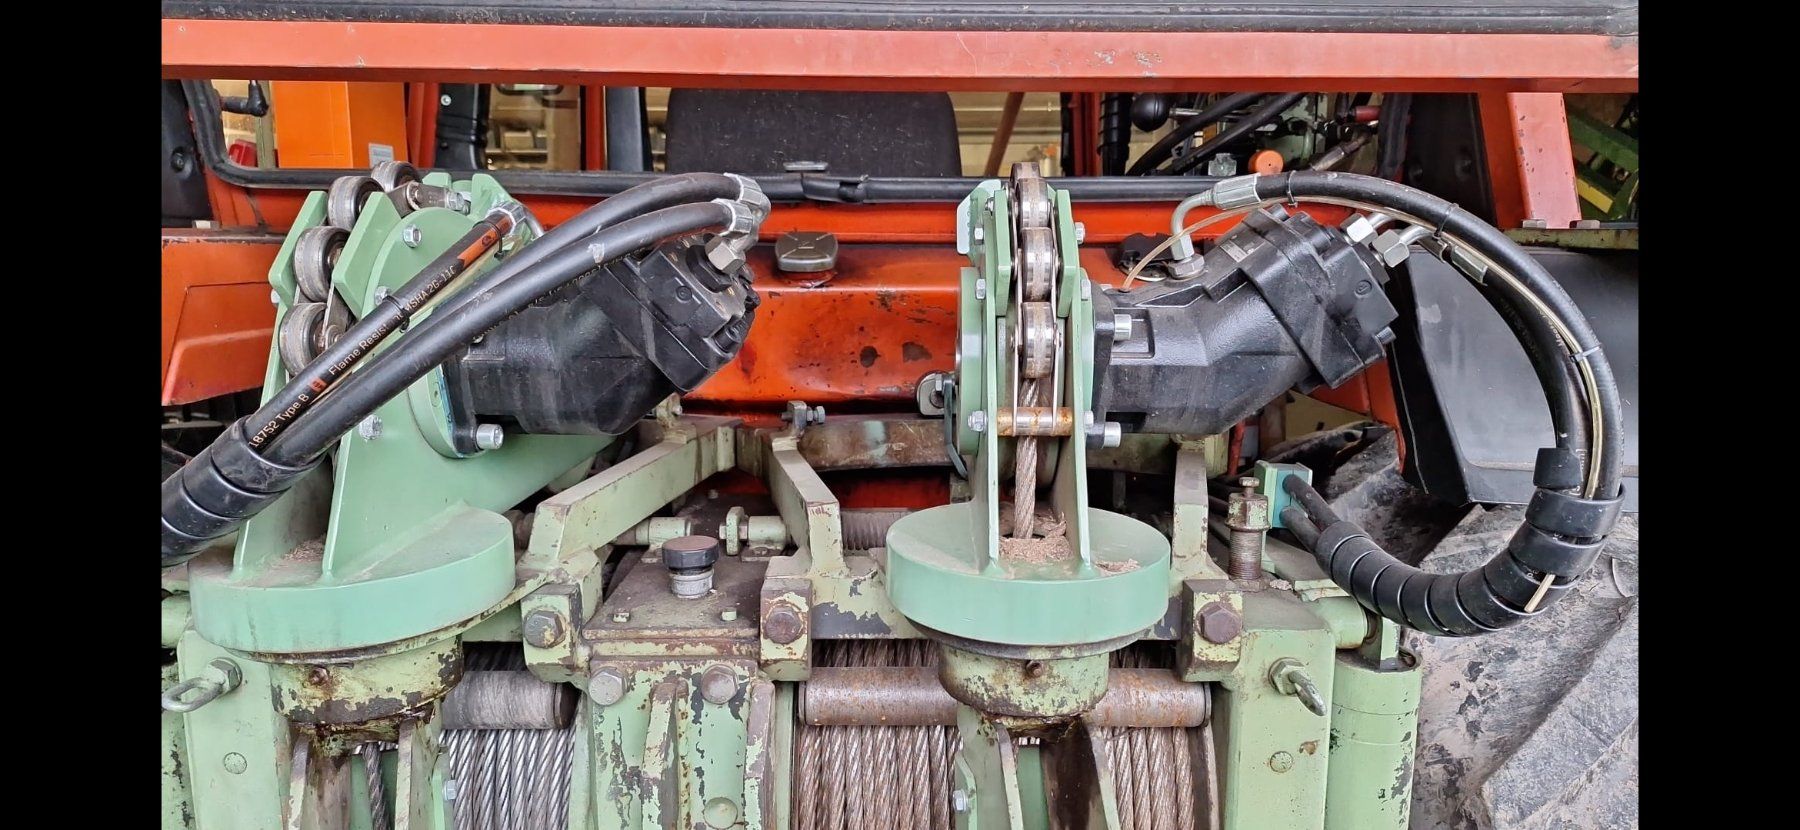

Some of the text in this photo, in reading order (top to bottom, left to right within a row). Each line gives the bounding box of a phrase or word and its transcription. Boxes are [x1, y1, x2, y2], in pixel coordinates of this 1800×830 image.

[248, 420, 281, 447] 18752
[275, 401, 301, 421] Type
[298, 393, 310, 402] B
[328, 349, 361, 375] Flame
